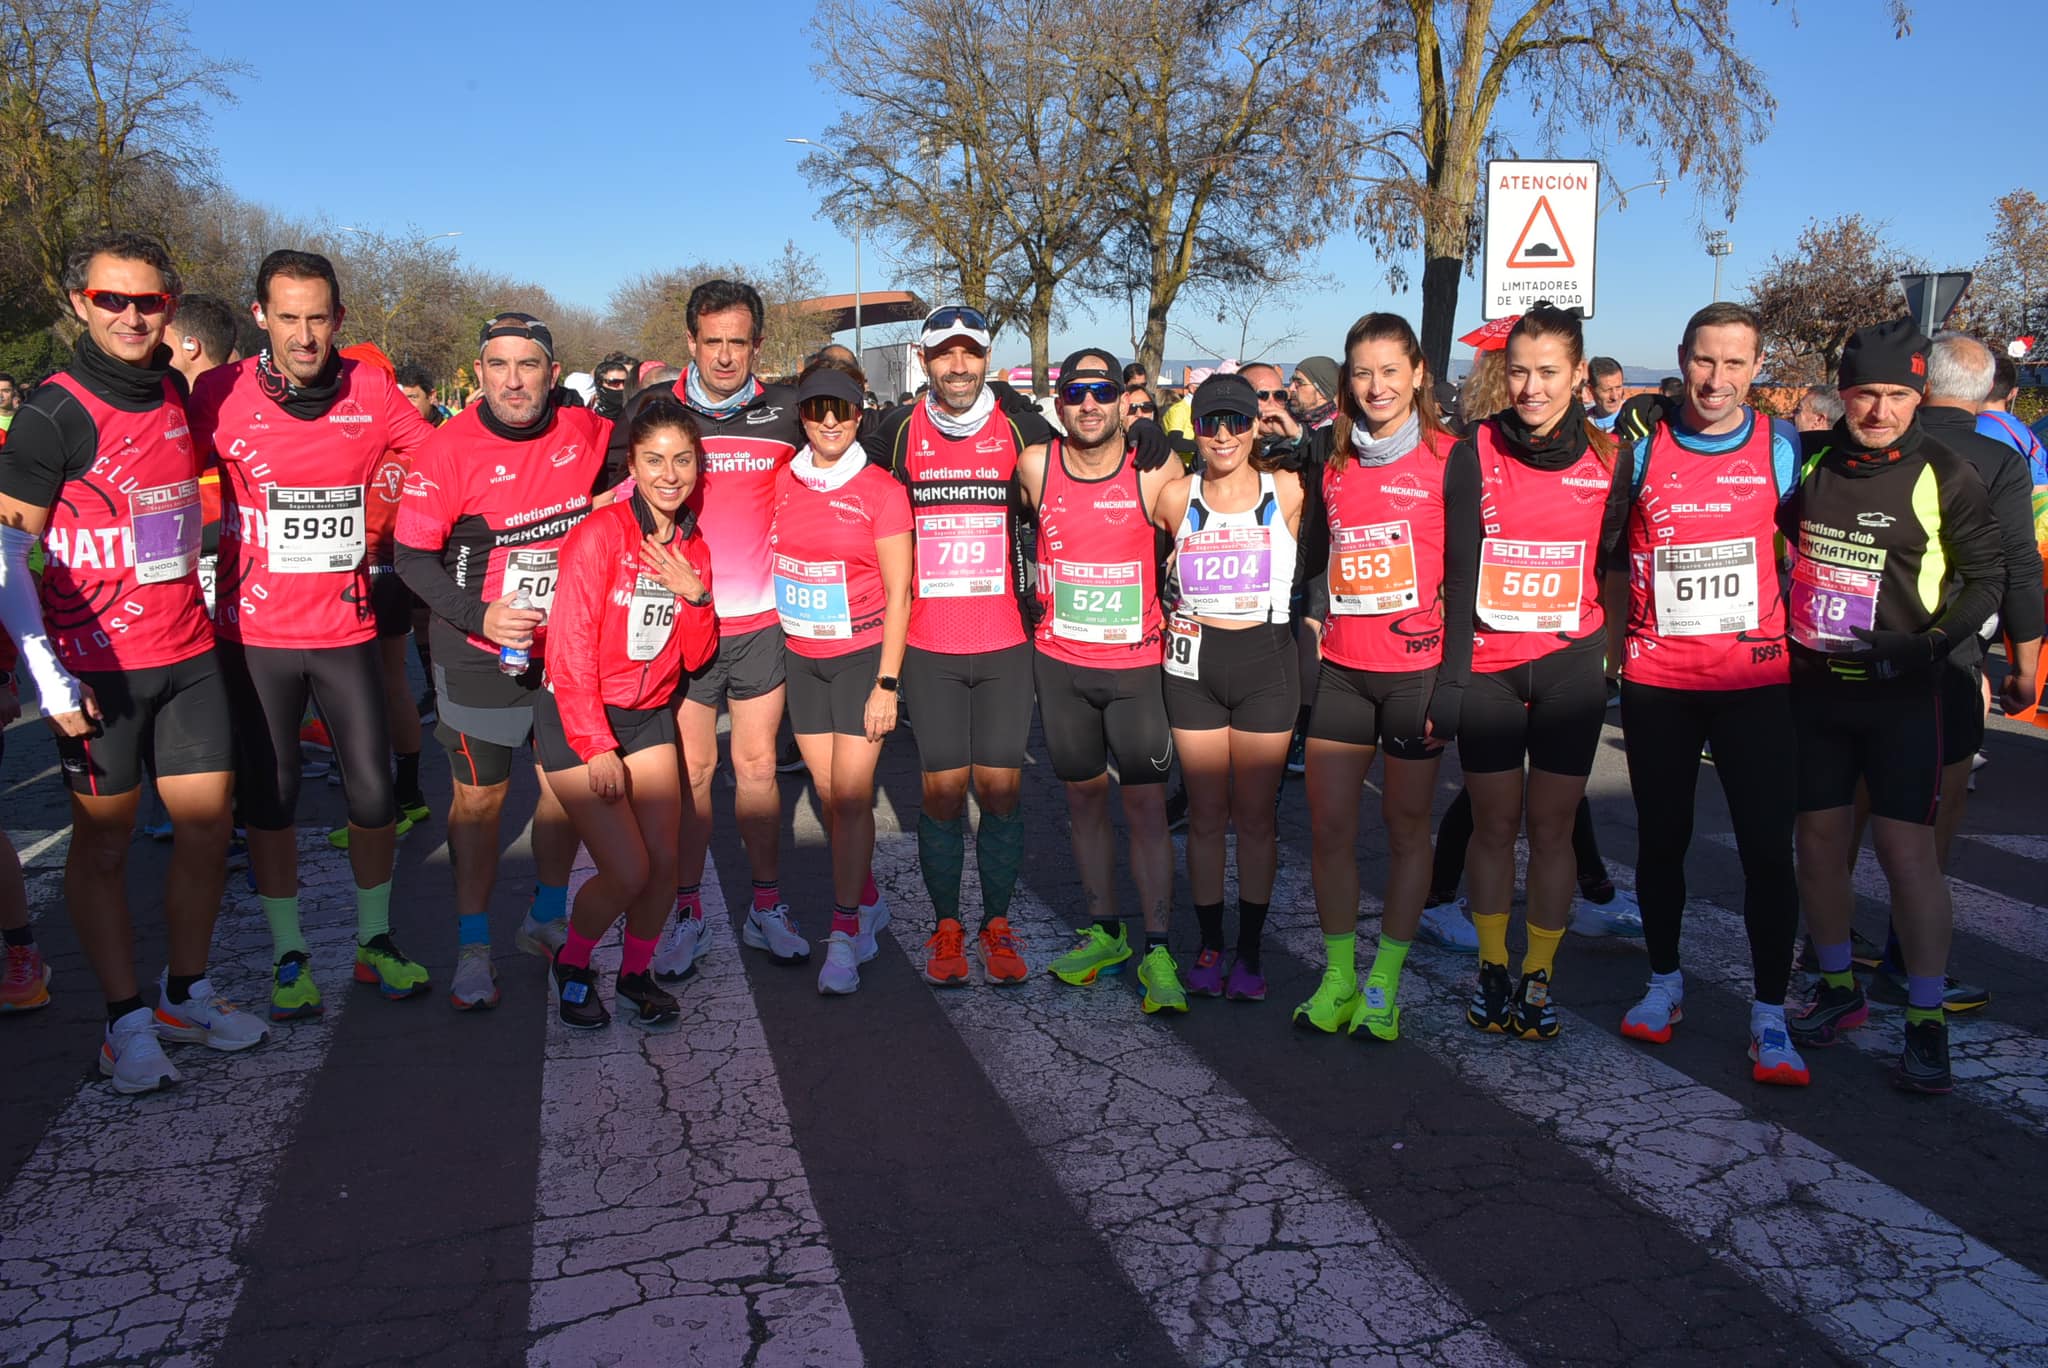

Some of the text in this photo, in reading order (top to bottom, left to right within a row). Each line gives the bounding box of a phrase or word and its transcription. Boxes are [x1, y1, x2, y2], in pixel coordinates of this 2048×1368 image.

[1499, 173, 1588, 190] ATENCIÓN
[1502, 280, 1578, 291] LIMITADORES
[1497, 296, 1512, 306] DE
[329, 415, 373, 424] MANCHATHON
[733, 451, 751, 459] club
[920, 467, 999, 480] atletismo club
[1716, 475, 1767, 485] MANCHATHON
[1380, 485, 1429, 498] MANCHATHON
[1562, 477, 1609, 489] MANCHATHON
[277, 489, 356, 503] SOLISS
[913, 486, 1007, 502] MANCHATHON
[505, 494, 587, 527] atletismo club
[1671, 503, 1732, 513] SOLISS
[173, 513, 185, 540] 7
[283, 516, 354, 539] 5930
[496, 512, 589, 546] MANCHATHO
[924, 517, 998, 531] SOLISS
[1188, 529, 1264, 545] SOLISS
[1848, 531, 1875, 545] club
[938, 541, 986, 566] 709
[1492, 544, 1575, 559] SOLISS
[1665, 544, 1747, 564] SOLISS
[778, 558, 837, 577] SOLISS
[1062, 564, 1135, 579] SOLISS
[1193, 555, 1259, 581] 1204
[1340, 553, 1391, 581] 553
[1503, 572, 1560, 597] 560
[1676, 573, 1740, 601] 6110
[786, 584, 828, 610] 888
[1073, 590, 1123, 613] 524
[643, 604, 674, 626] 616
[1405, 635, 1440, 654] 1999
[1751, 644, 1782, 665] 1999
